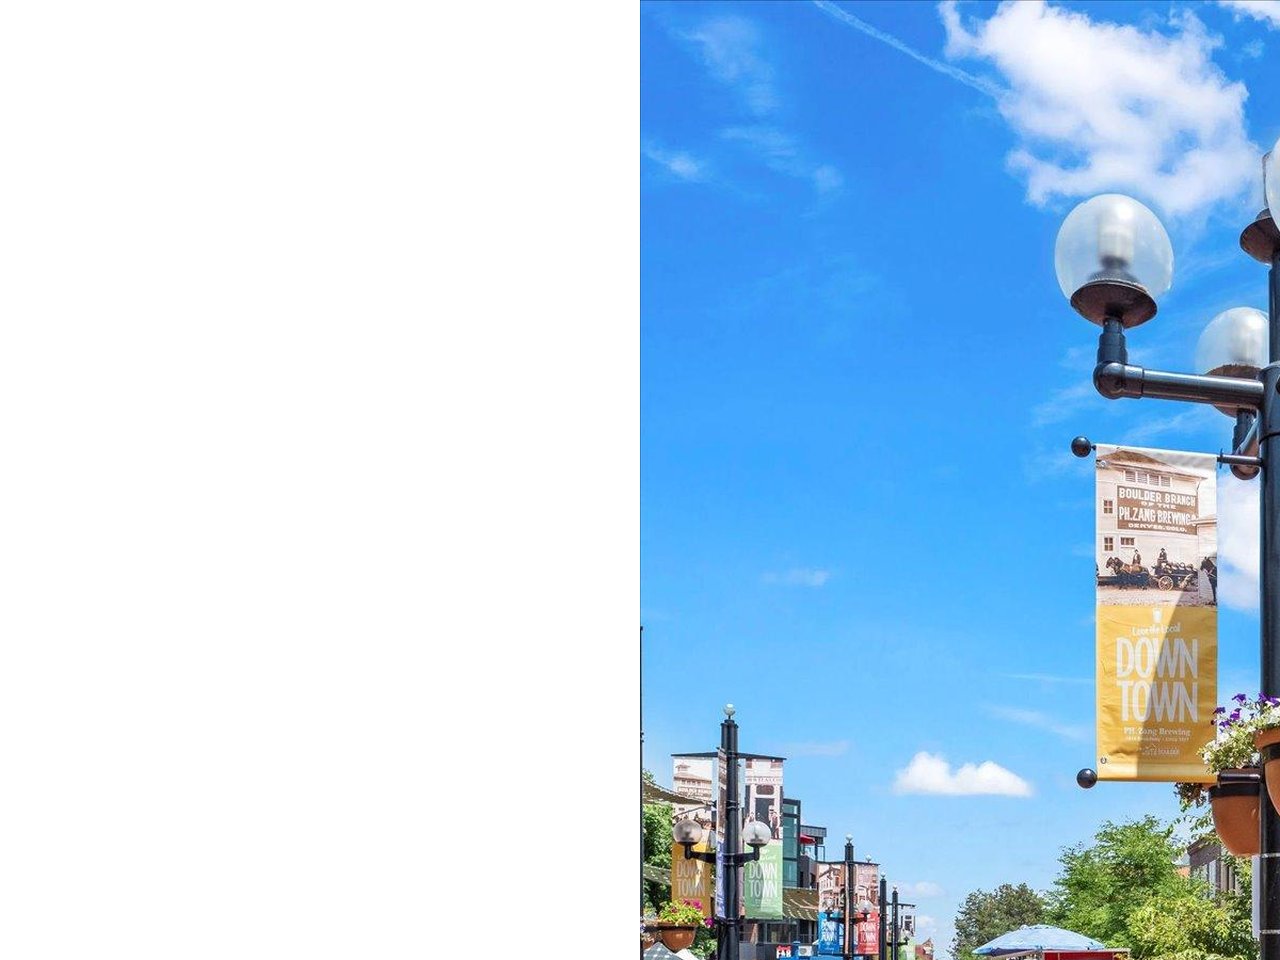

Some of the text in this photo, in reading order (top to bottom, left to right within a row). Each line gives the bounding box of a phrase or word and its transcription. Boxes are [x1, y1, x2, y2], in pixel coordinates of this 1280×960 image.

[1120, 487, 1196, 507] BOULDER BRANCH
[1116, 636, 1198, 679] DOWN
[1116, 680, 1198, 723] TOWN
[749, 862, 778, 880] DOWN
[676, 878, 705, 897] TOWN
[749, 879, 778, 898] TOWN
